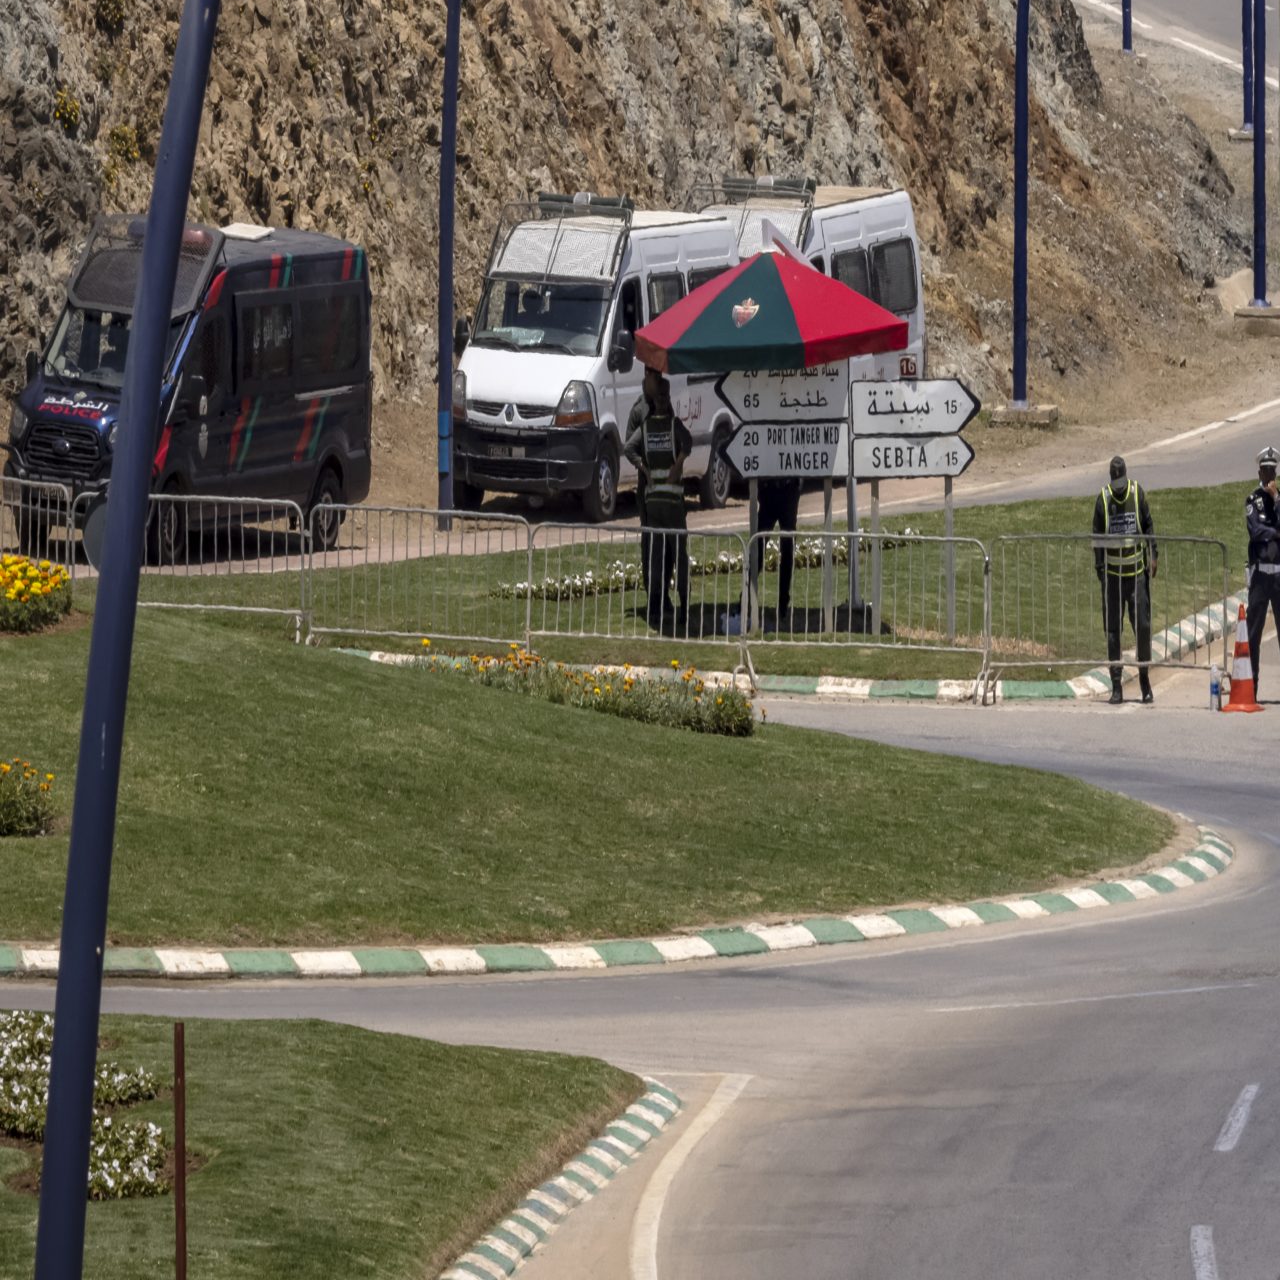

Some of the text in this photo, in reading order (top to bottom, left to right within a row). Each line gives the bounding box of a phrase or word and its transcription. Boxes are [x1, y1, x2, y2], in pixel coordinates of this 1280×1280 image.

[900, 359, 917, 375] 16
[44, 396, 109, 411] الشرطة
[743, 390, 829, 413] طنجة 65
[867, 390, 958, 424] سبتة 15
[38, 404, 102, 420] POLICE
[743, 426, 840, 446] 20 PORT TANGER MED
[779, 452, 829, 470] TANGER
[872, 446, 958, 469] SEBTA 15
